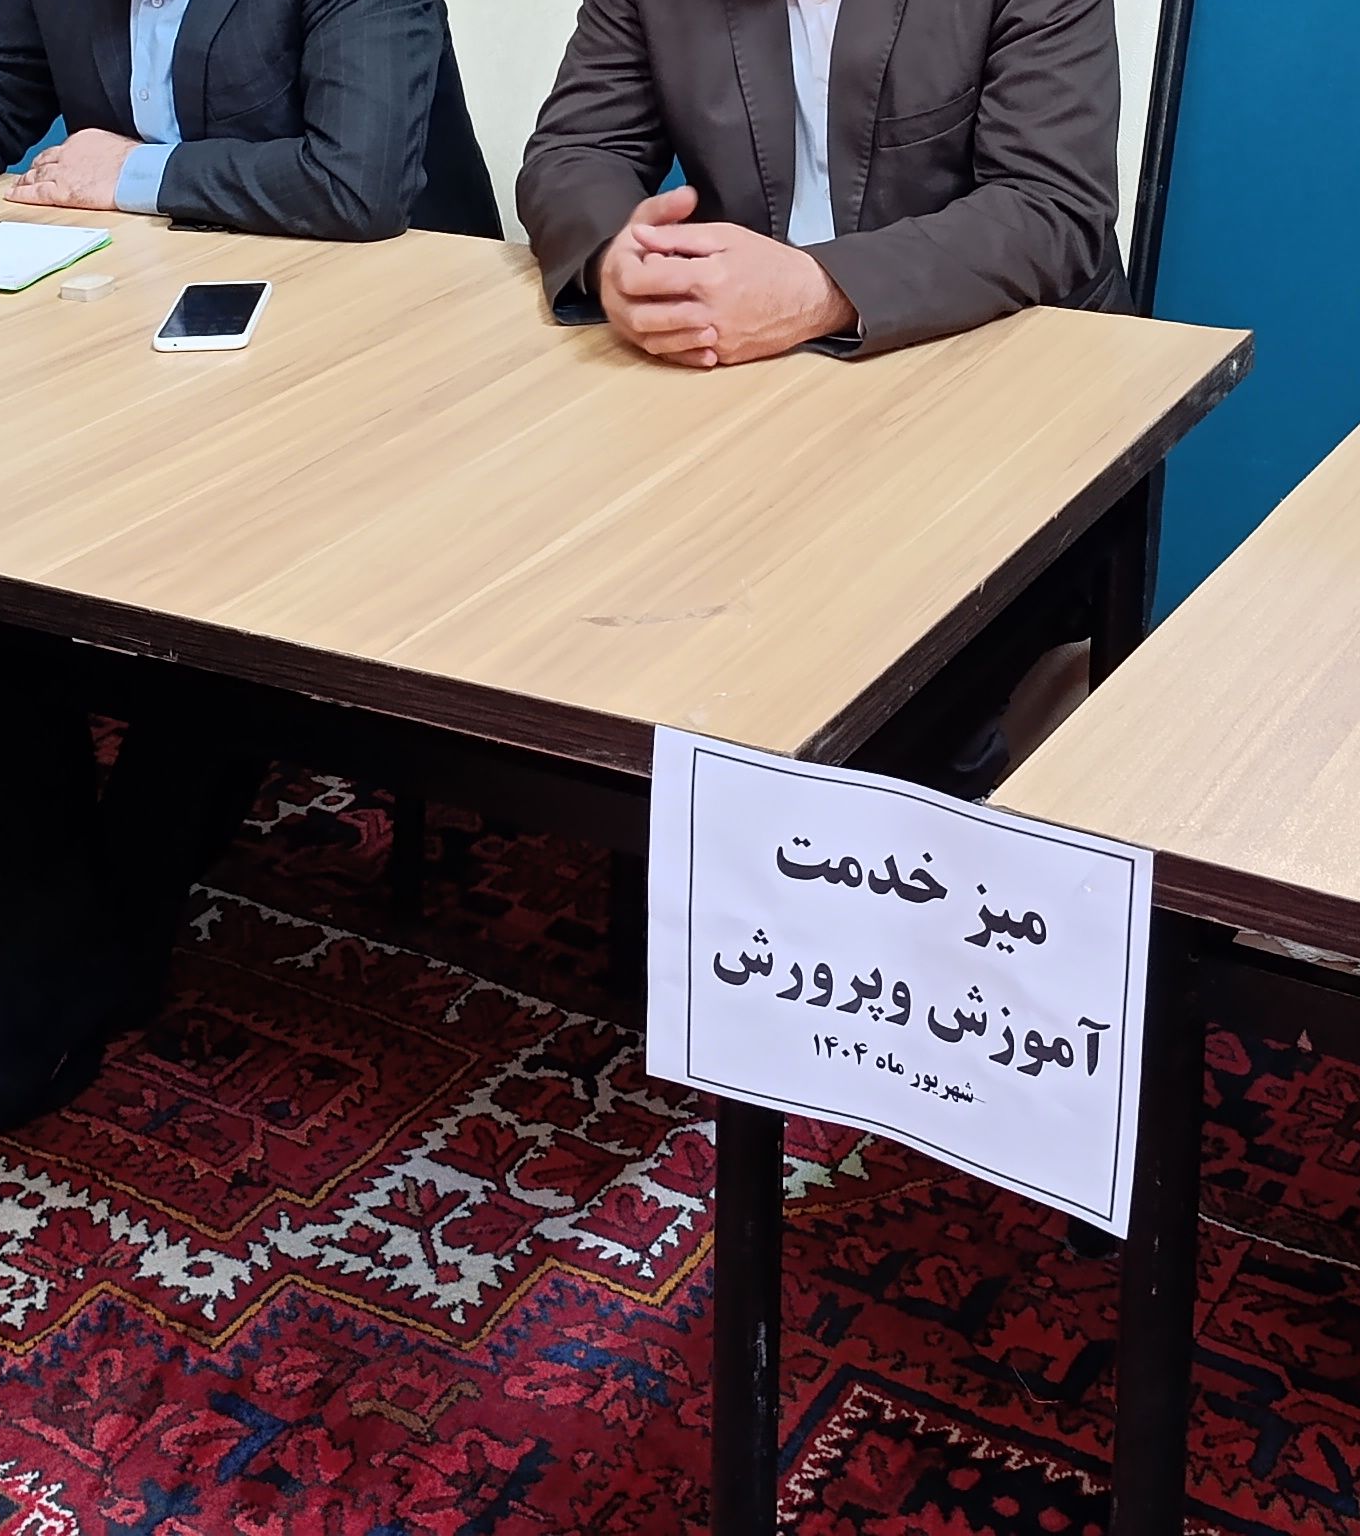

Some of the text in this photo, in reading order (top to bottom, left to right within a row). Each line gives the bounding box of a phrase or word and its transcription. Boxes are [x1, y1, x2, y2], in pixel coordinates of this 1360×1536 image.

[777, 837, 1046, 953] میز خدمت
[814, 1034, 984, 1103] شهریور ماه ۱۴۰۴
[927, 986, 1110, 1077] آموزش
